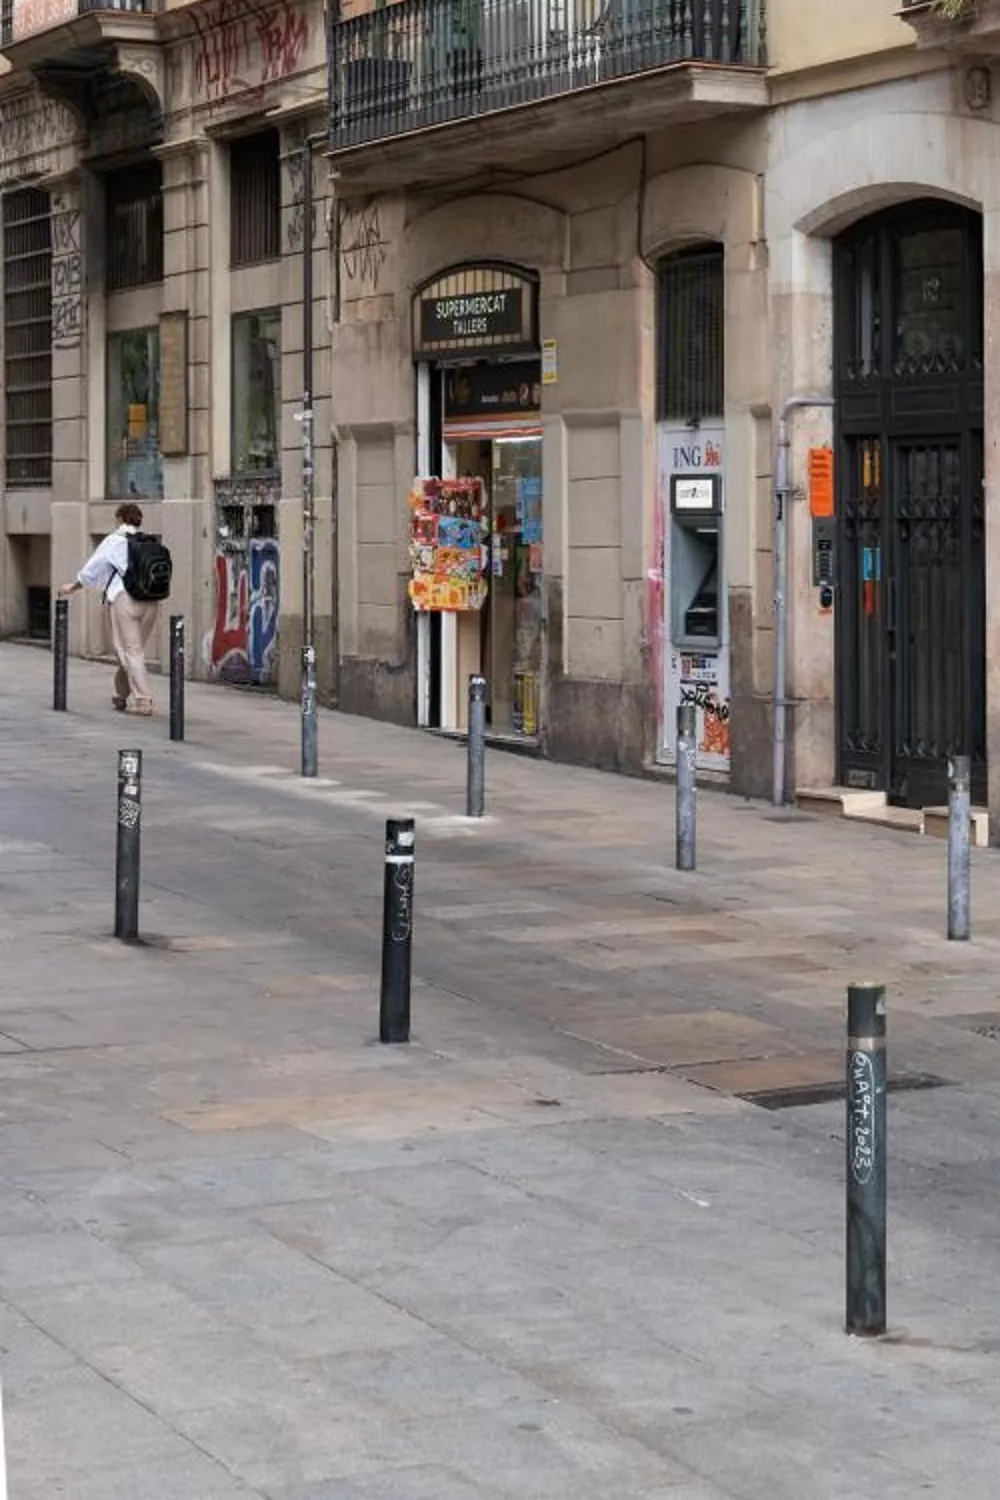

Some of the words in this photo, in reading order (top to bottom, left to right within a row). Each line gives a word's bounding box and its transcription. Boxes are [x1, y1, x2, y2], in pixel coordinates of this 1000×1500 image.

[435, 294, 507, 319] SUPERMERCAT
[453, 317, 487, 334] TALLERS
[672, 446, 702, 468] ING
